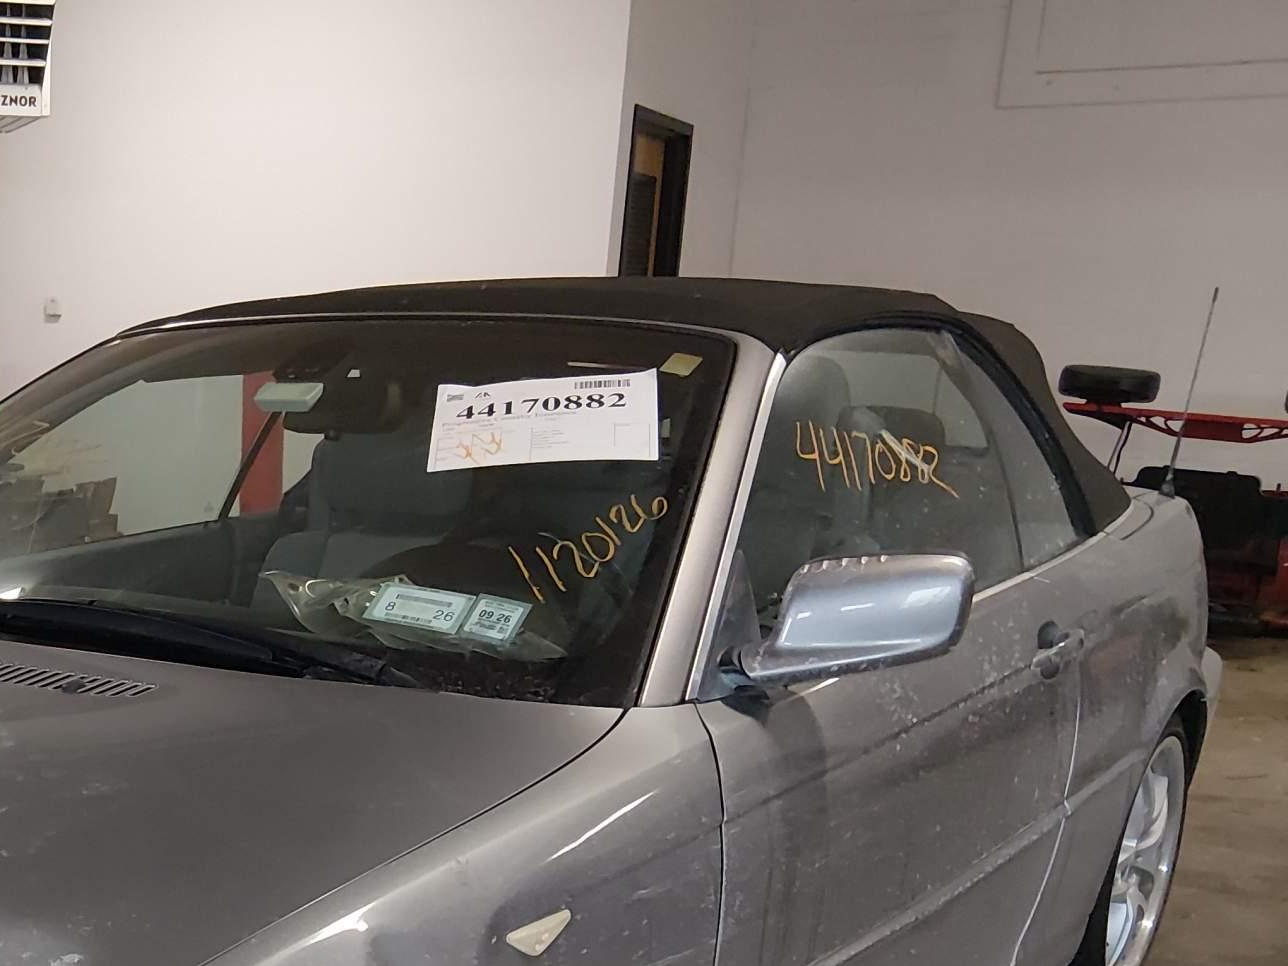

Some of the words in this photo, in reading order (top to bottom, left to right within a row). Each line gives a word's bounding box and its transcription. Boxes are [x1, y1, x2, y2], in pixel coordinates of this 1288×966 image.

[456, 393, 627, 420] 44170882
[796, 420, 960, 499] 44170882
[384, 601, 396, 612] 8
[433, 609, 456, 622] 26
[478, 609, 495, 619] 09
[496, 613, 513, 624] 26
